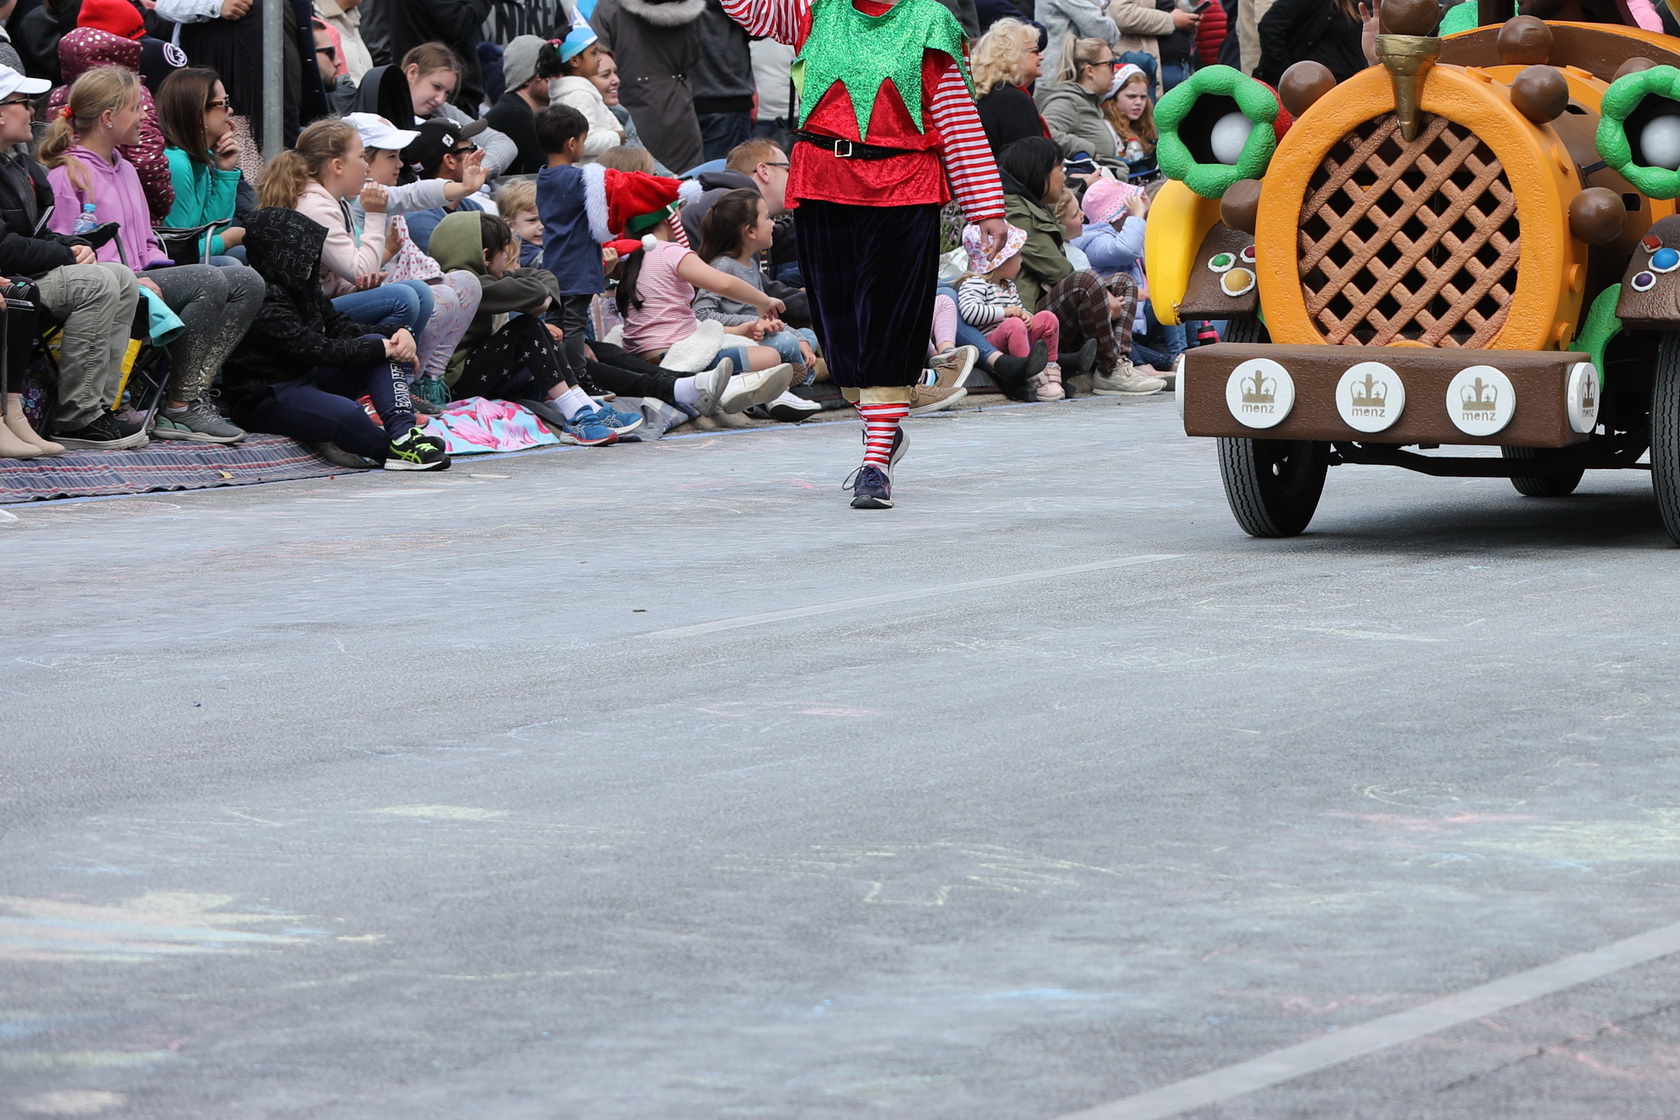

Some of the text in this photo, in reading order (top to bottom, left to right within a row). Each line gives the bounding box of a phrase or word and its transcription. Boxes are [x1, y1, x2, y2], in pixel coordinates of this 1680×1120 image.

[1241, 404, 1275, 414] menz
[1351, 407, 1386, 418] menz
[1462, 411, 1496, 421] menz
